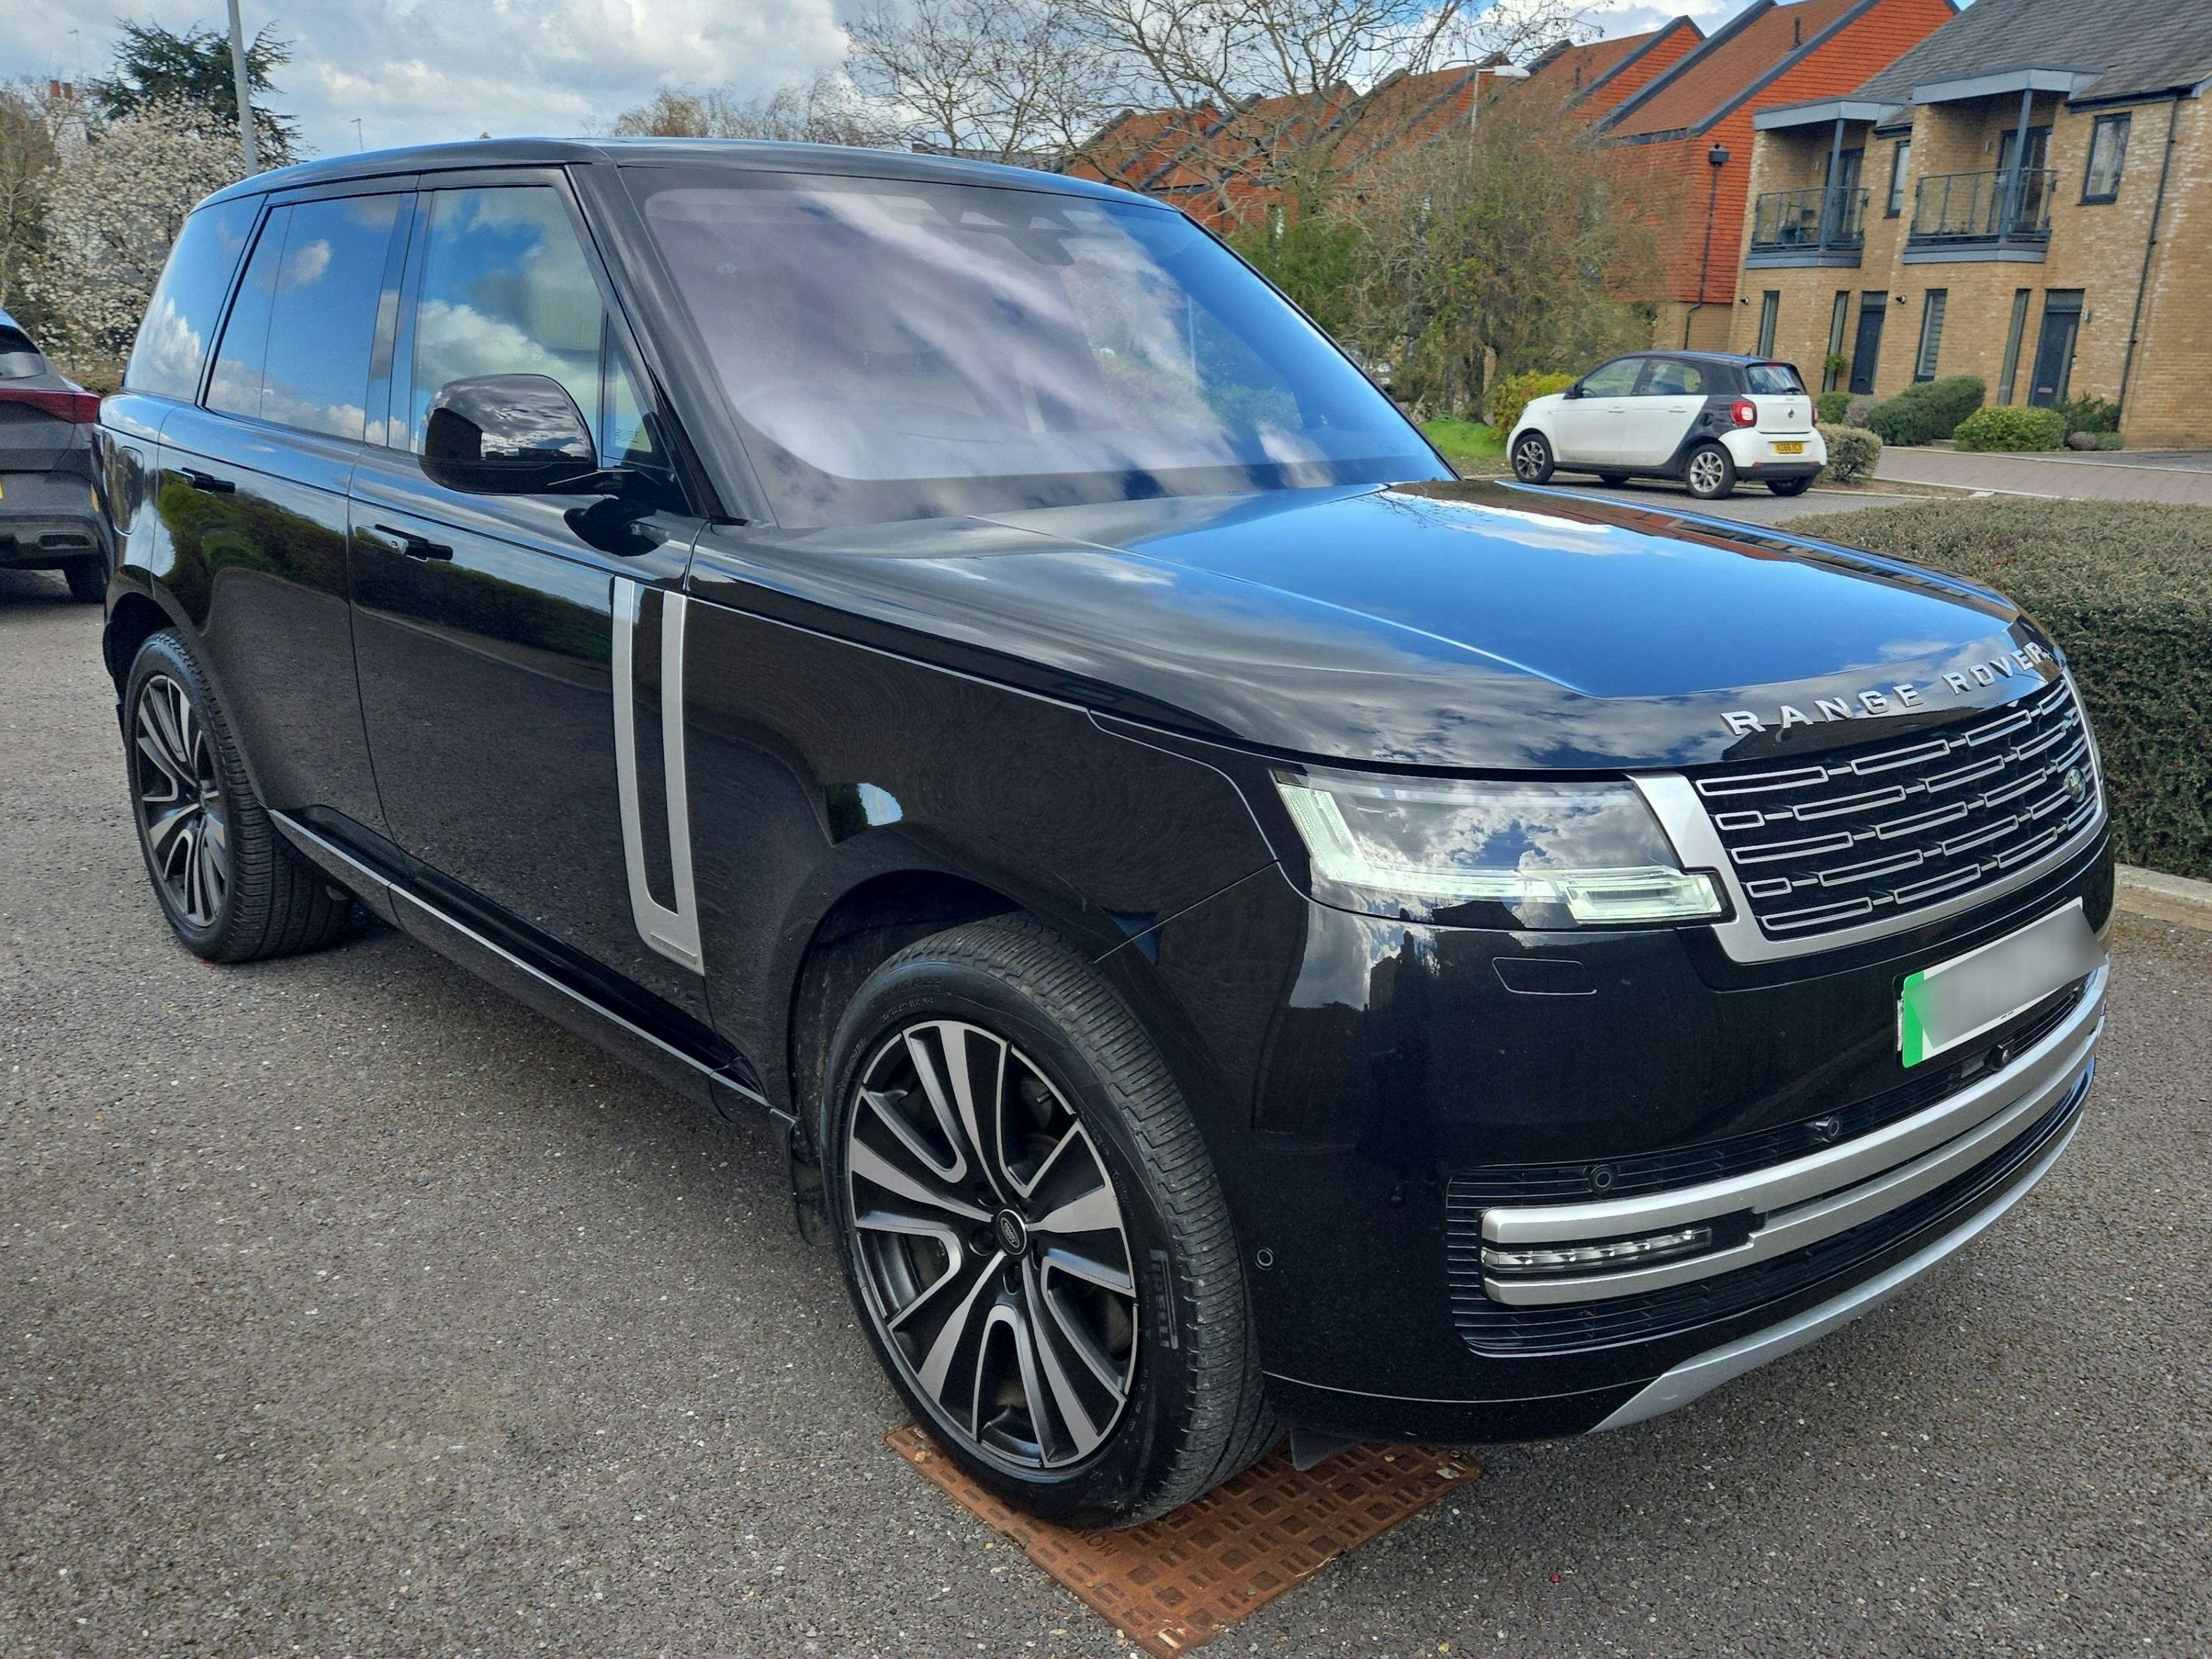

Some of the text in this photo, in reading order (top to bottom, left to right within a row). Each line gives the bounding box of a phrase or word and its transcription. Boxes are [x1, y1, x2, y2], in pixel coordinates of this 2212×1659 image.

[1720, 641, 2053, 736] RANGE ROVER
[1149, 1250, 1179, 1350] PIRELLI
